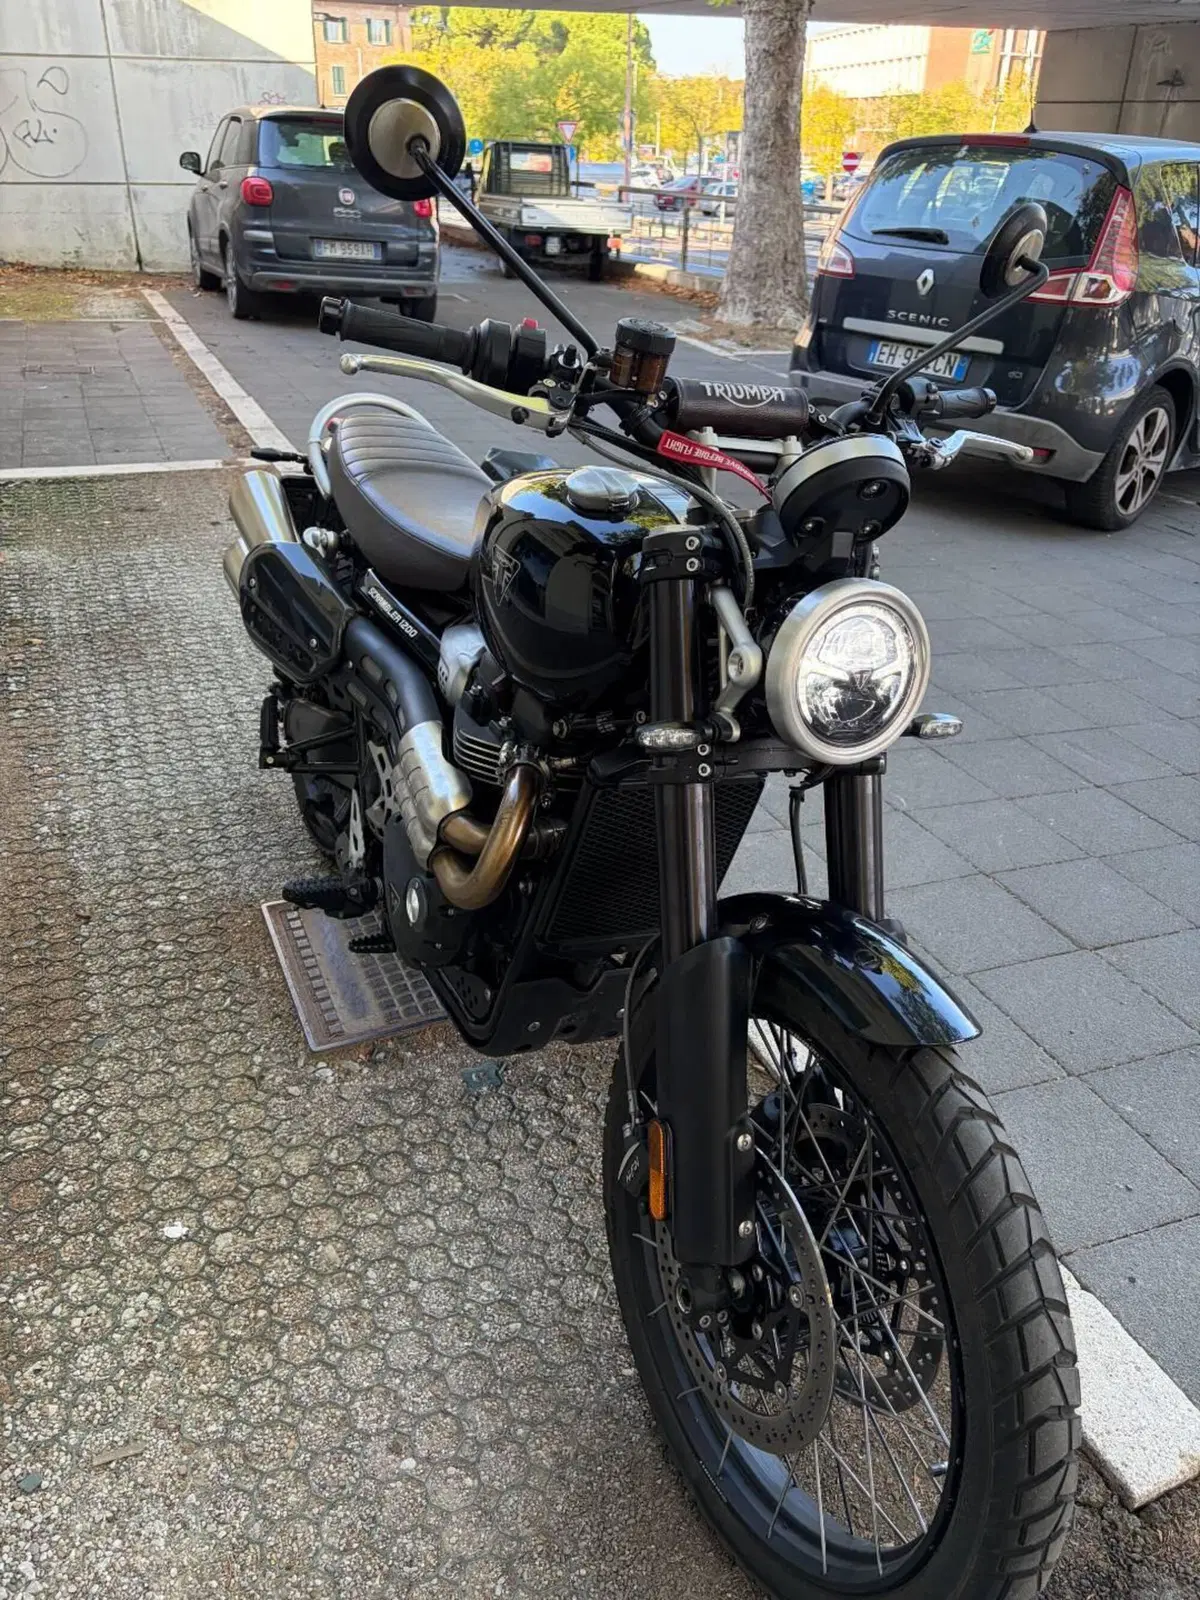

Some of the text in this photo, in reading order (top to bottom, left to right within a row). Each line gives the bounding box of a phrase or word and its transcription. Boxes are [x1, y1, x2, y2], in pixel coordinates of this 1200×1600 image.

[887, 309, 950, 327] SCENIC
[877, 343, 898, 365] EH
[700, 382, 785, 407] TRIUMPH
[664, 438, 694, 455] FLIGHT
[693, 447, 725, 464] BEFORE
[368, 587, 418, 638] SCRAMBLER 1200
